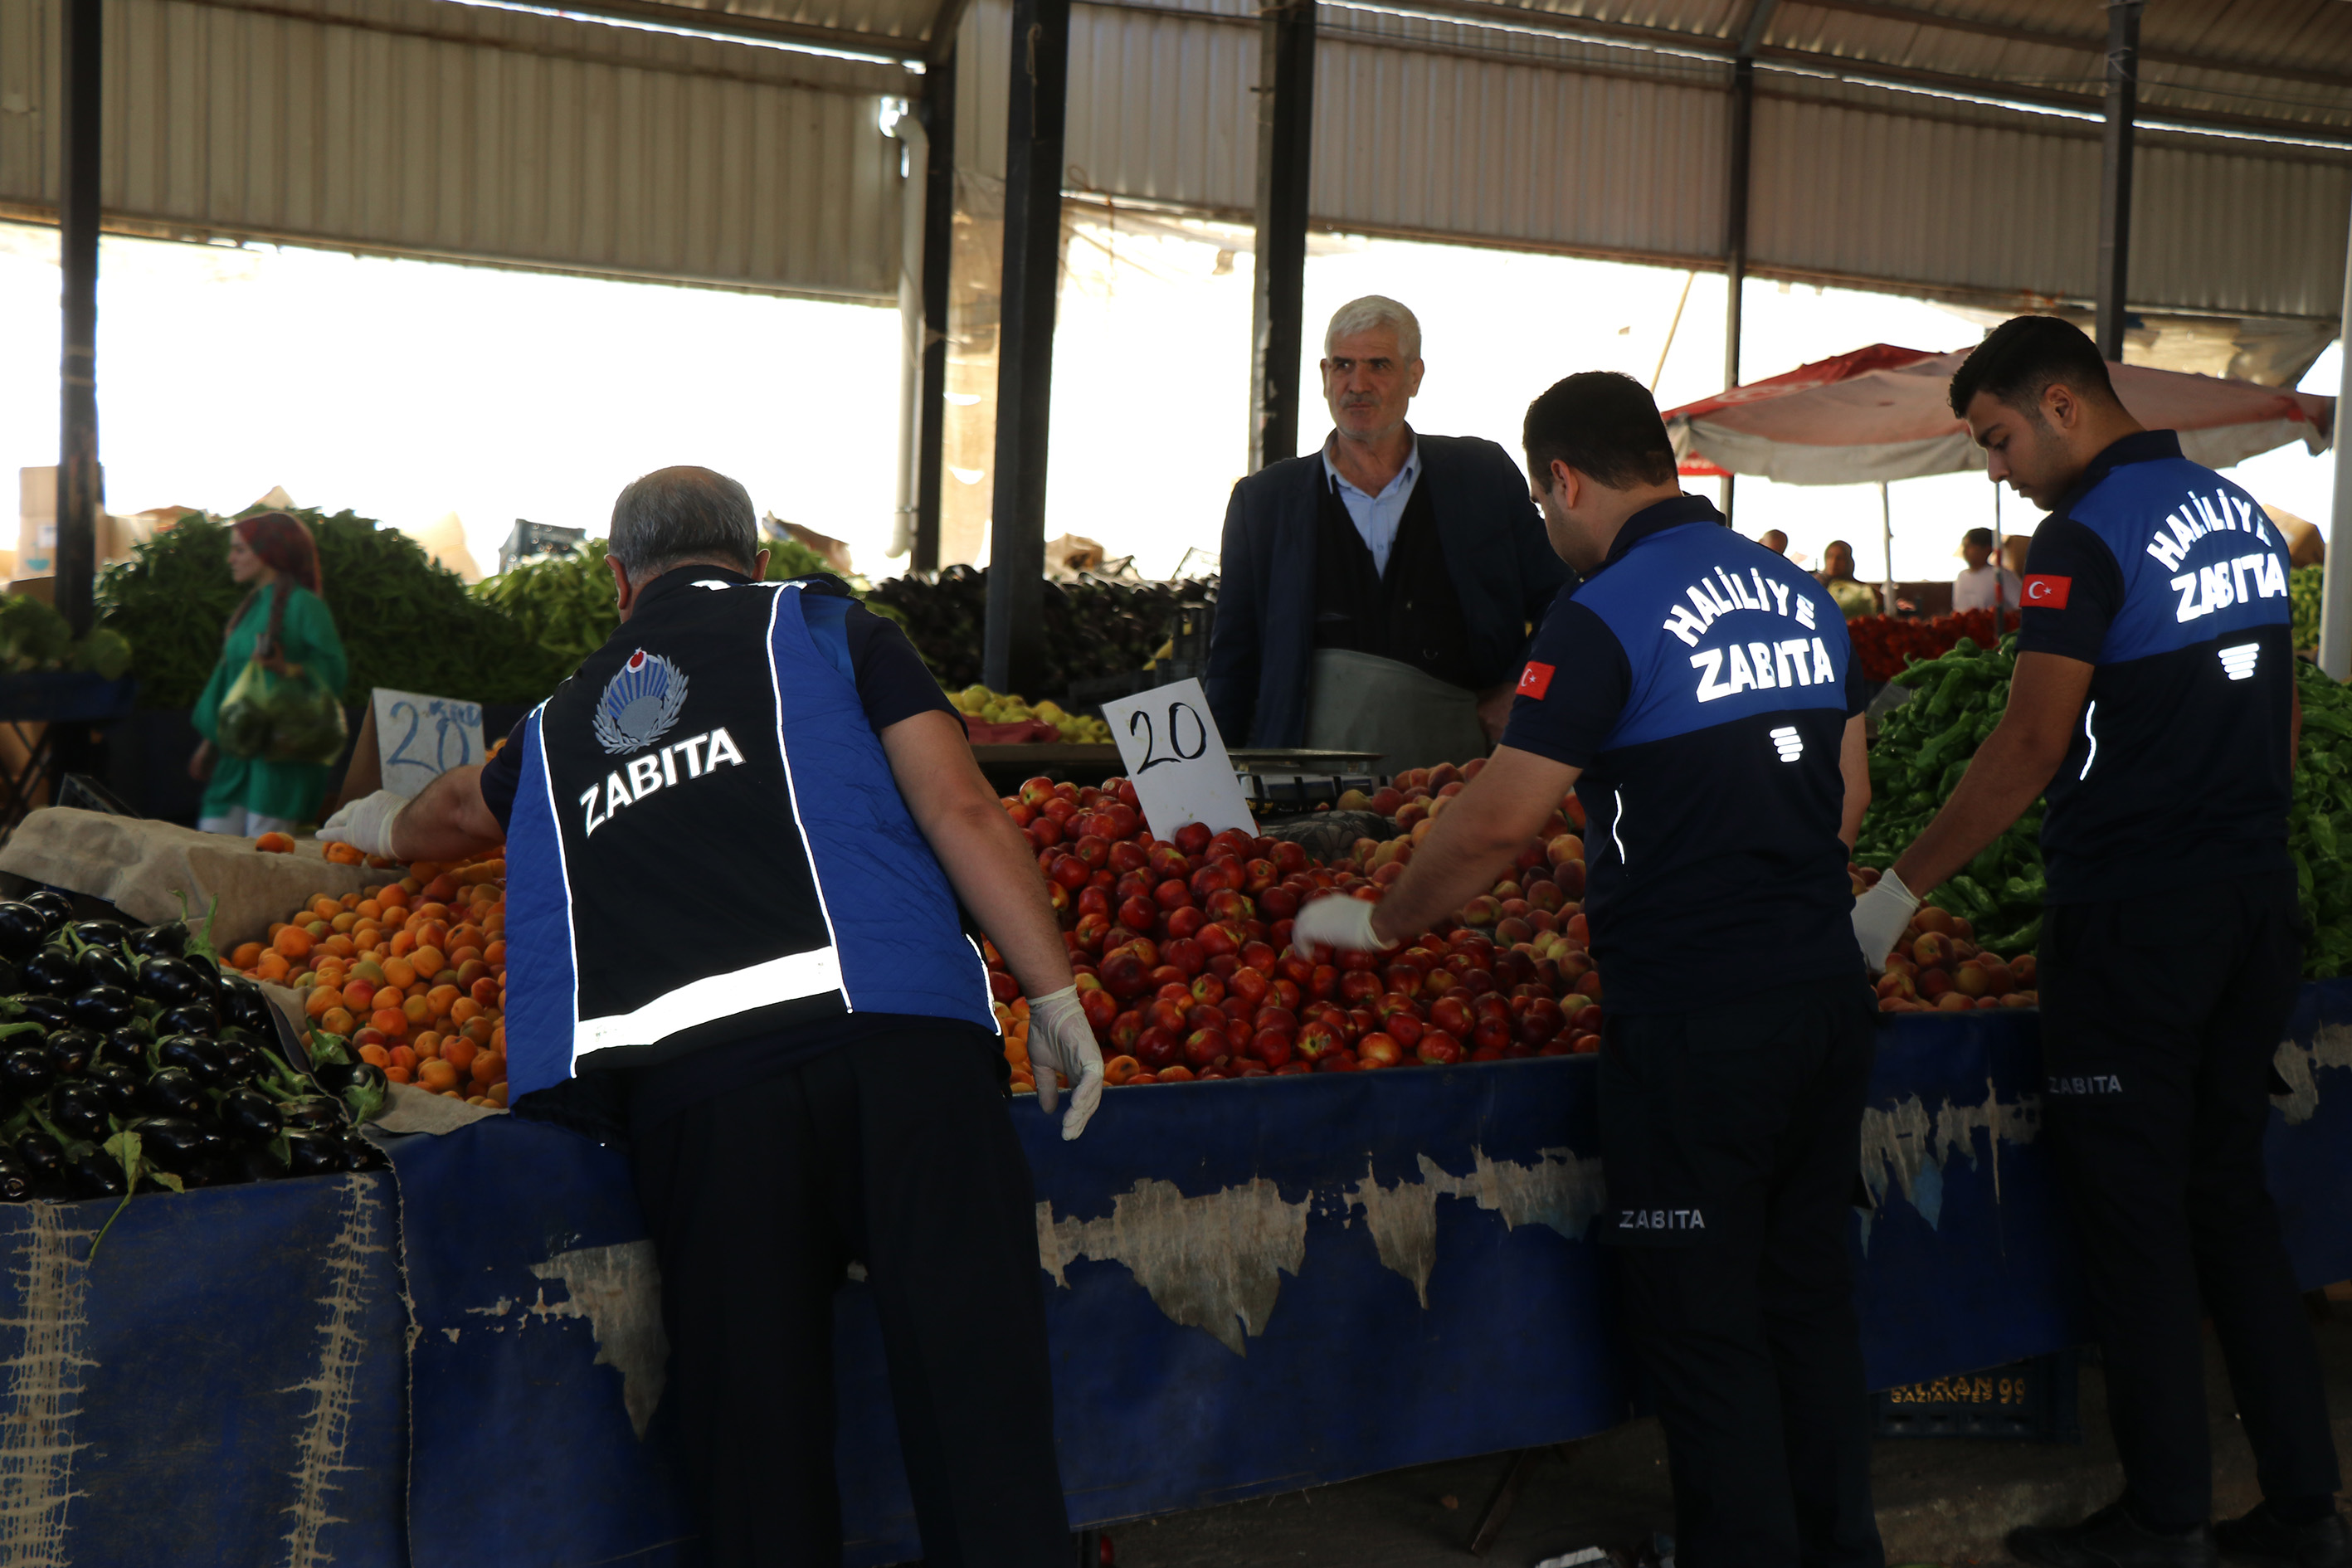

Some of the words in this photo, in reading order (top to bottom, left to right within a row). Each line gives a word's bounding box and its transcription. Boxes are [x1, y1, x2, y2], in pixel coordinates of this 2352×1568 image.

[1663, 566, 1816, 648] HALİLİYE
[2169, 553, 2288, 624] ZABITA
[1689, 636, 1835, 704] ZABITA
[386, 700, 470, 775] 20
[1130, 702, 1207, 775] 20
[579, 727, 747, 838] ZABITA
[2048, 1074, 2123, 1094] ZABITA
[1619, 1209, 1706, 1229] ZABITA
